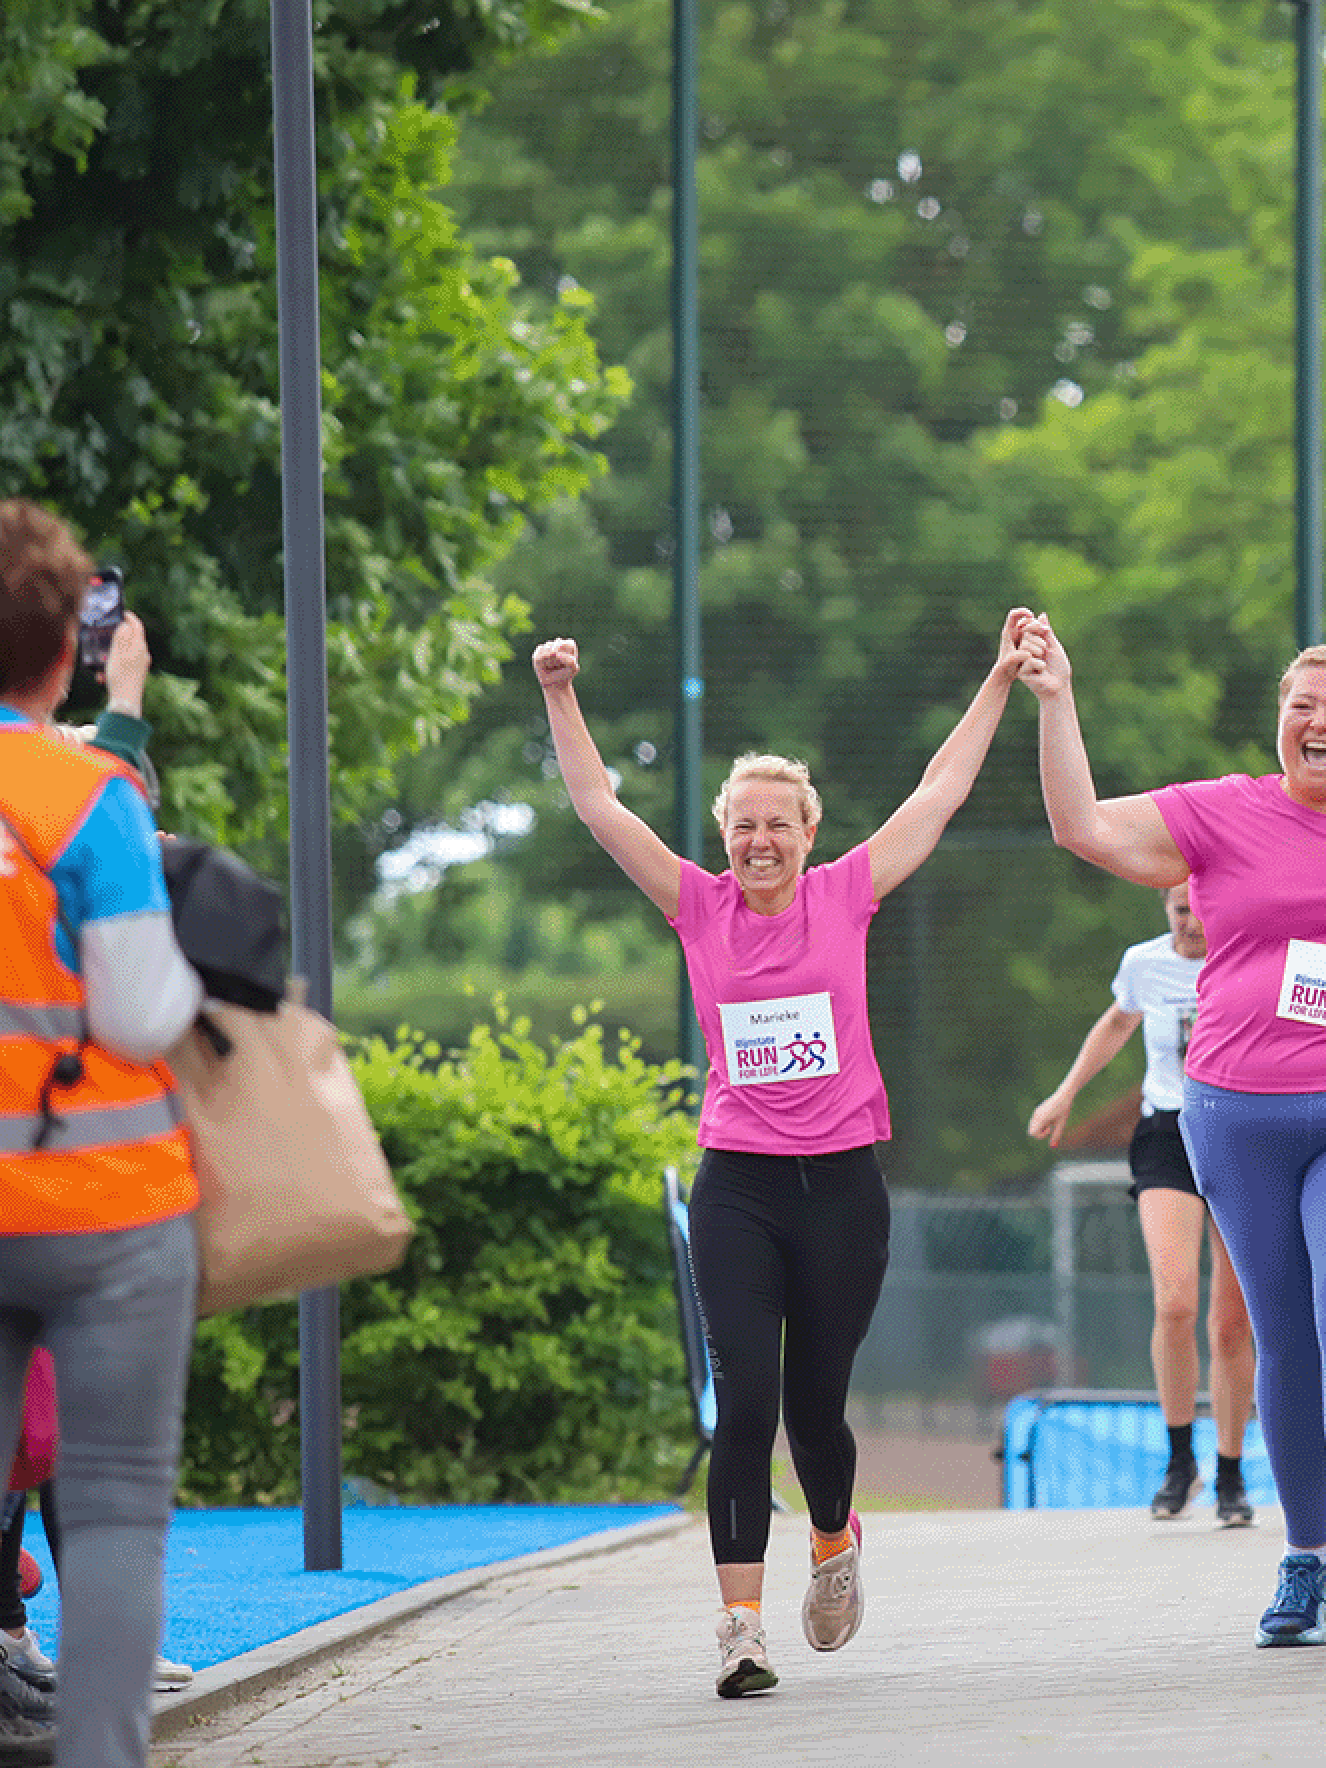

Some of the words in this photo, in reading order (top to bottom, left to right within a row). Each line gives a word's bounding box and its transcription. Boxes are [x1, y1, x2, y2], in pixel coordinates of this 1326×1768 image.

[749, 1010, 799, 1024] Marieke
[1288, 1004, 1308, 1017] FOR
[736, 1046, 778, 1069] RUN
[738, 1068, 757, 1079] FOR
[759, 1066, 778, 1077] LIFE
